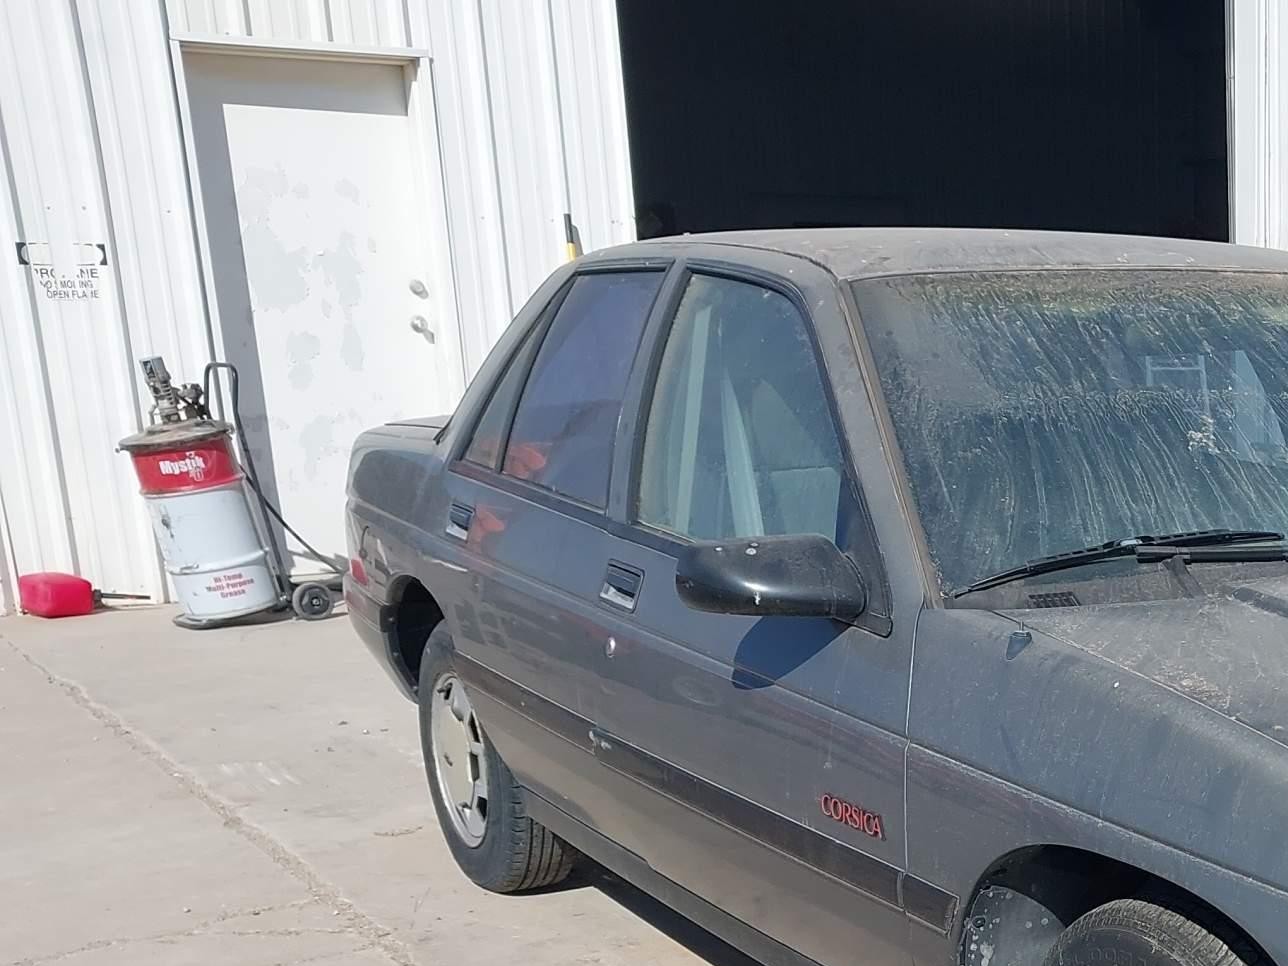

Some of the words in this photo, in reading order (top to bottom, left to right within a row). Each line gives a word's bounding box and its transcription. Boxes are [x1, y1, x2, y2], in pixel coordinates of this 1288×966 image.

[47, 290, 70, 299] OPEN
[159, 452, 206, 475] Mystik
[821, 793, 883, 839] CORSICA
